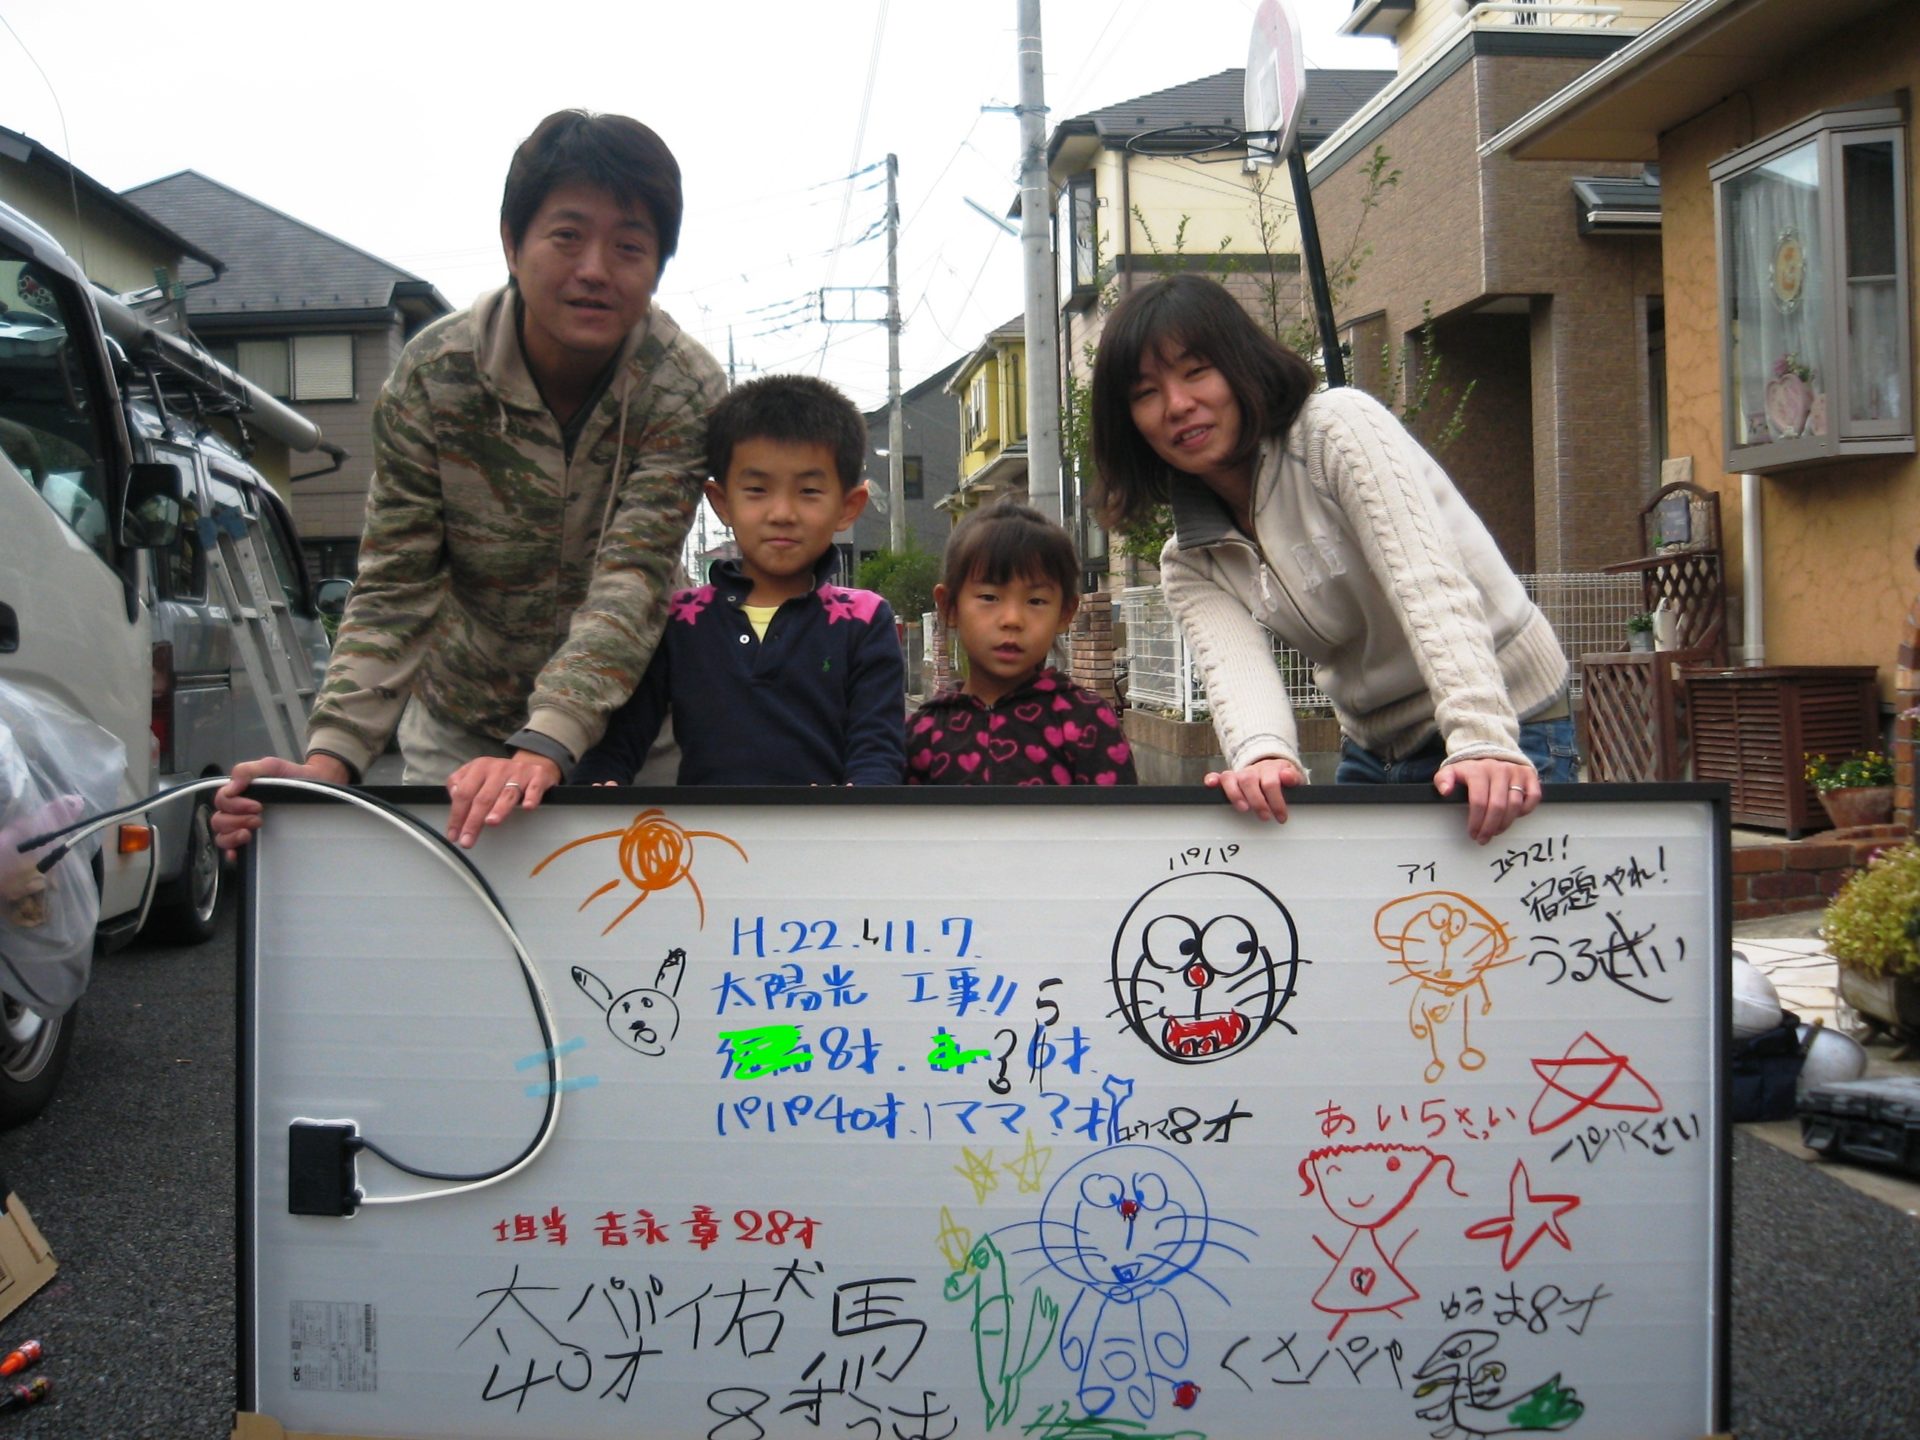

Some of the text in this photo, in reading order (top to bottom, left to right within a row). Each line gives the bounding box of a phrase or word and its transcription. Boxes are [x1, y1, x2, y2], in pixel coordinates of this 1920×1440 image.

[1397, 861, 1437, 884] アイ
[711, 963, 869, 1015] 太陽光
